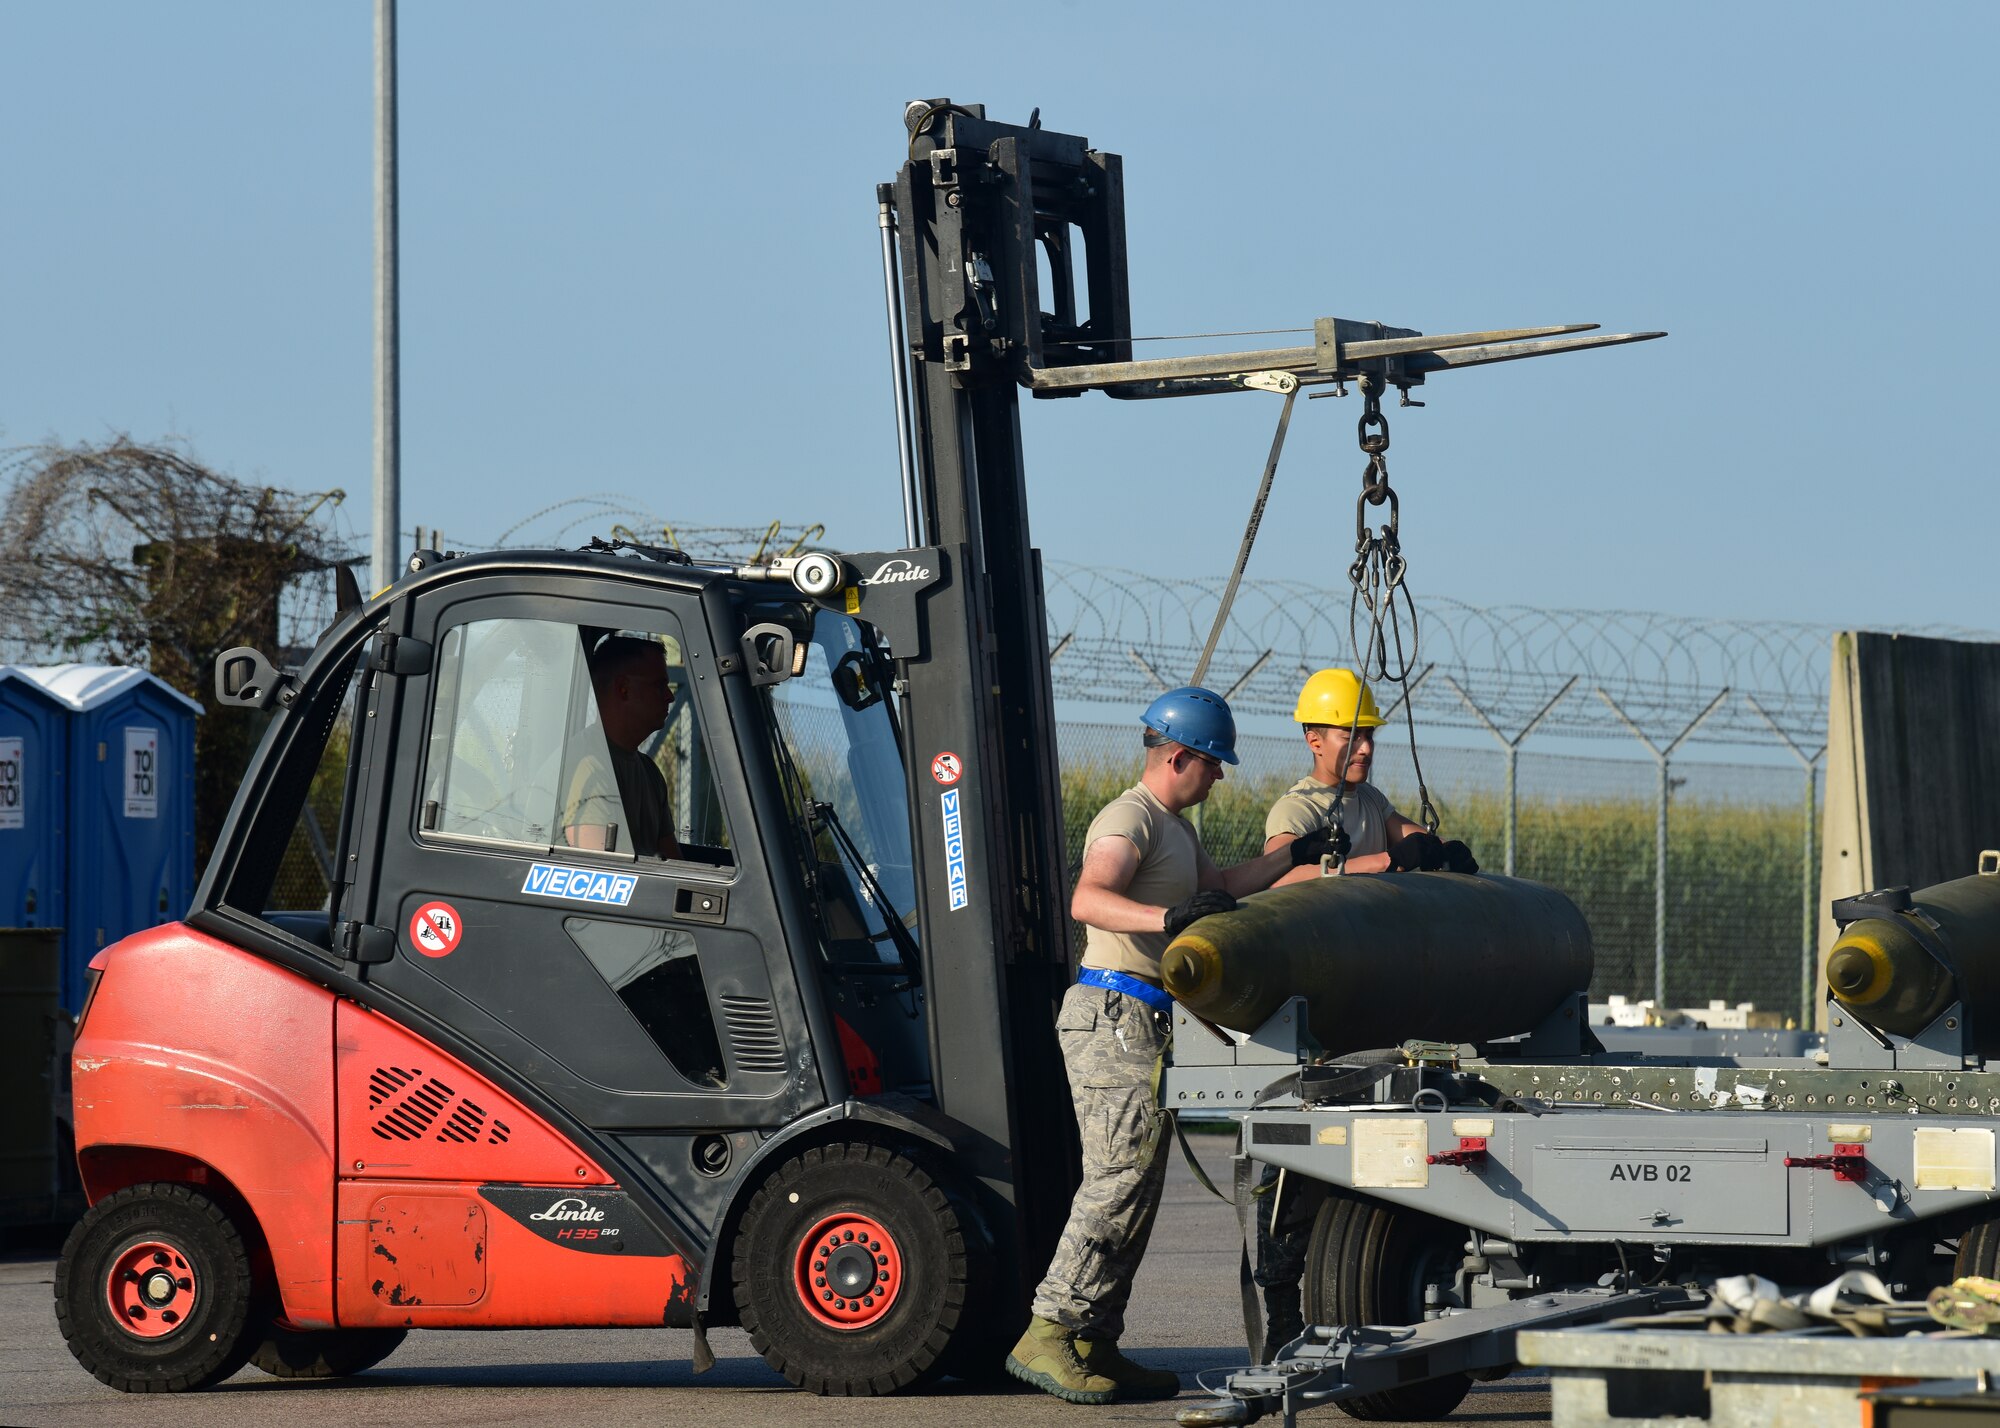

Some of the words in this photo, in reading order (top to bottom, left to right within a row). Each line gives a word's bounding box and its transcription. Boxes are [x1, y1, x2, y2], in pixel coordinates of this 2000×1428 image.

[858, 560, 930, 586] Linde
[133, 750, 154, 773] TOI
[133, 774, 154, 796] TOI
[945, 795, 966, 905] VECAR
[531, 868, 632, 903] VECAR
[1609, 1163, 1659, 1182] AVB
[1665, 1164, 1692, 1183] 02
[530, 1198, 605, 1222] Linde
[600, 1228, 620, 1236] EVO
